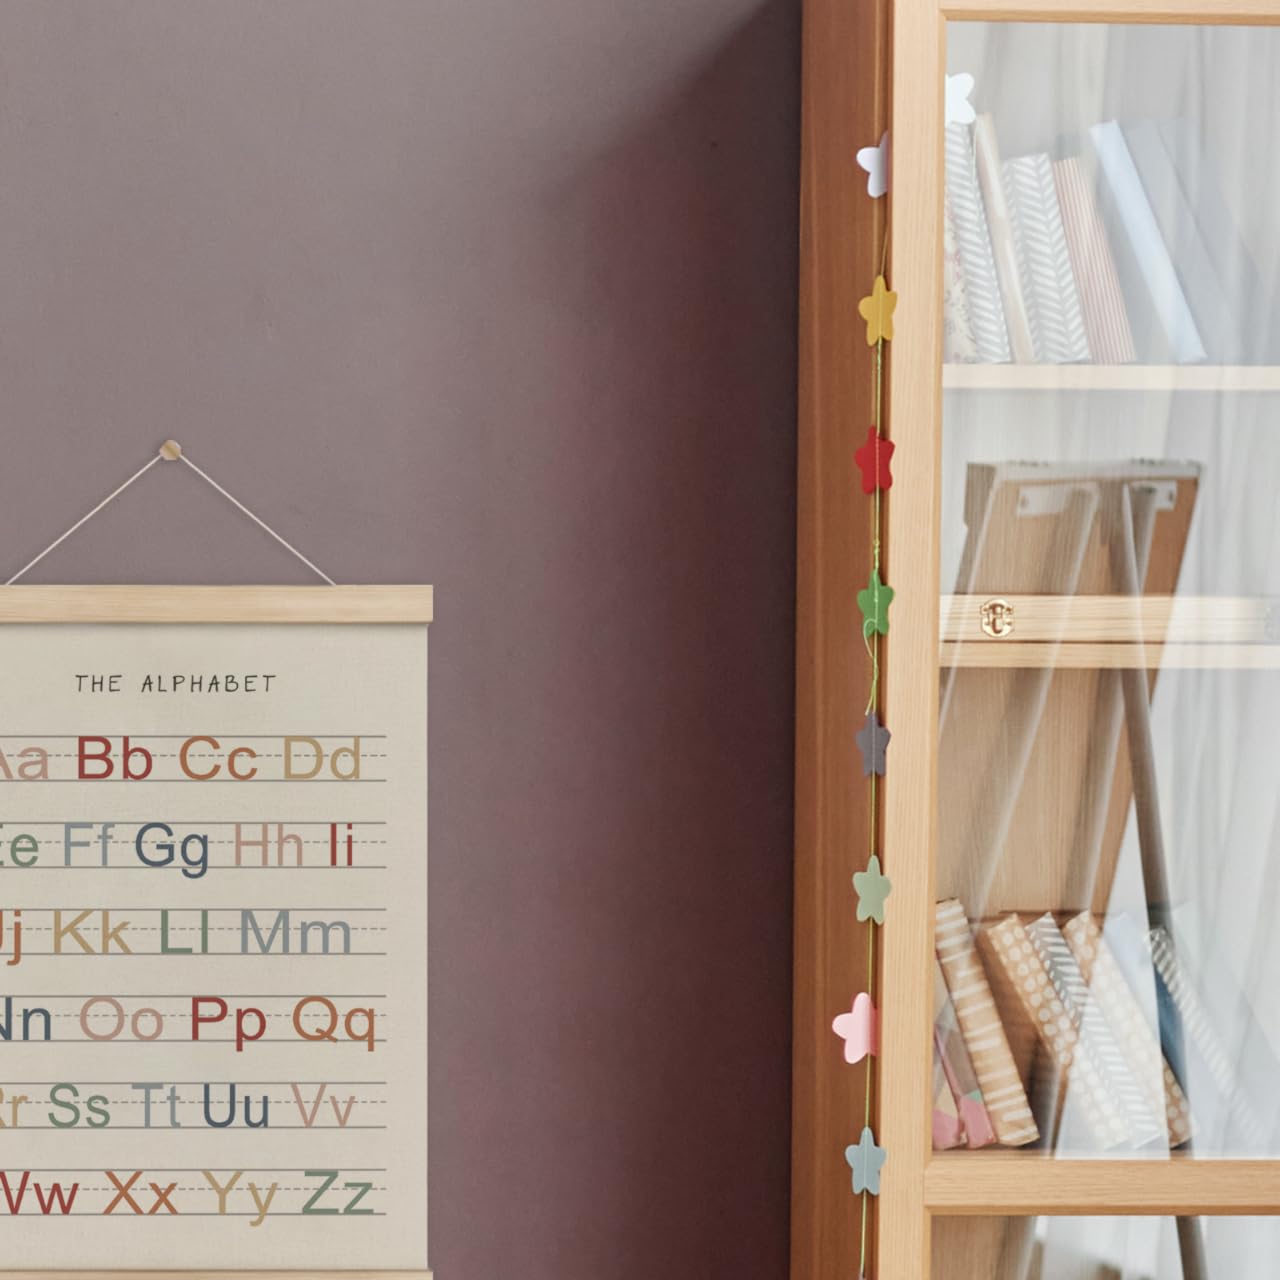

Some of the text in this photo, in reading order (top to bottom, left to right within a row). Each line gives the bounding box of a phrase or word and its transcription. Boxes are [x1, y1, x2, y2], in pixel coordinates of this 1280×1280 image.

[74, 674, 277, 694] THE ALPHABET
[77, 735, 154, 782] Bb
[178, 734, 259, 782] Cc
[283, 735, 361, 782] Dd
[63, 822, 116, 868] Ff
[134, 821, 209, 880] Gg
[234, 822, 303, 868] Hh
[329, 822, 353, 868] Ii
[53, 909, 133, 955] Kk
[160, 909, 209, 955] Ll
[240, 909, 351, 955] Mm
[79, 995, 164, 1042] Oo
[191, 996, 267, 1053] Pp
[291, 995, 375, 1053] Qq
[47, 1082, 112, 1129] Ss
[131, 1082, 181, 1129] Tt
[202, 1082, 269, 1129] Uu
[290, 1082, 356, 1128] Vv
[102, 1170, 180, 1216] Xx
[201, 1170, 279, 1228] Yy
[301, 1170, 375, 1216] Zz
